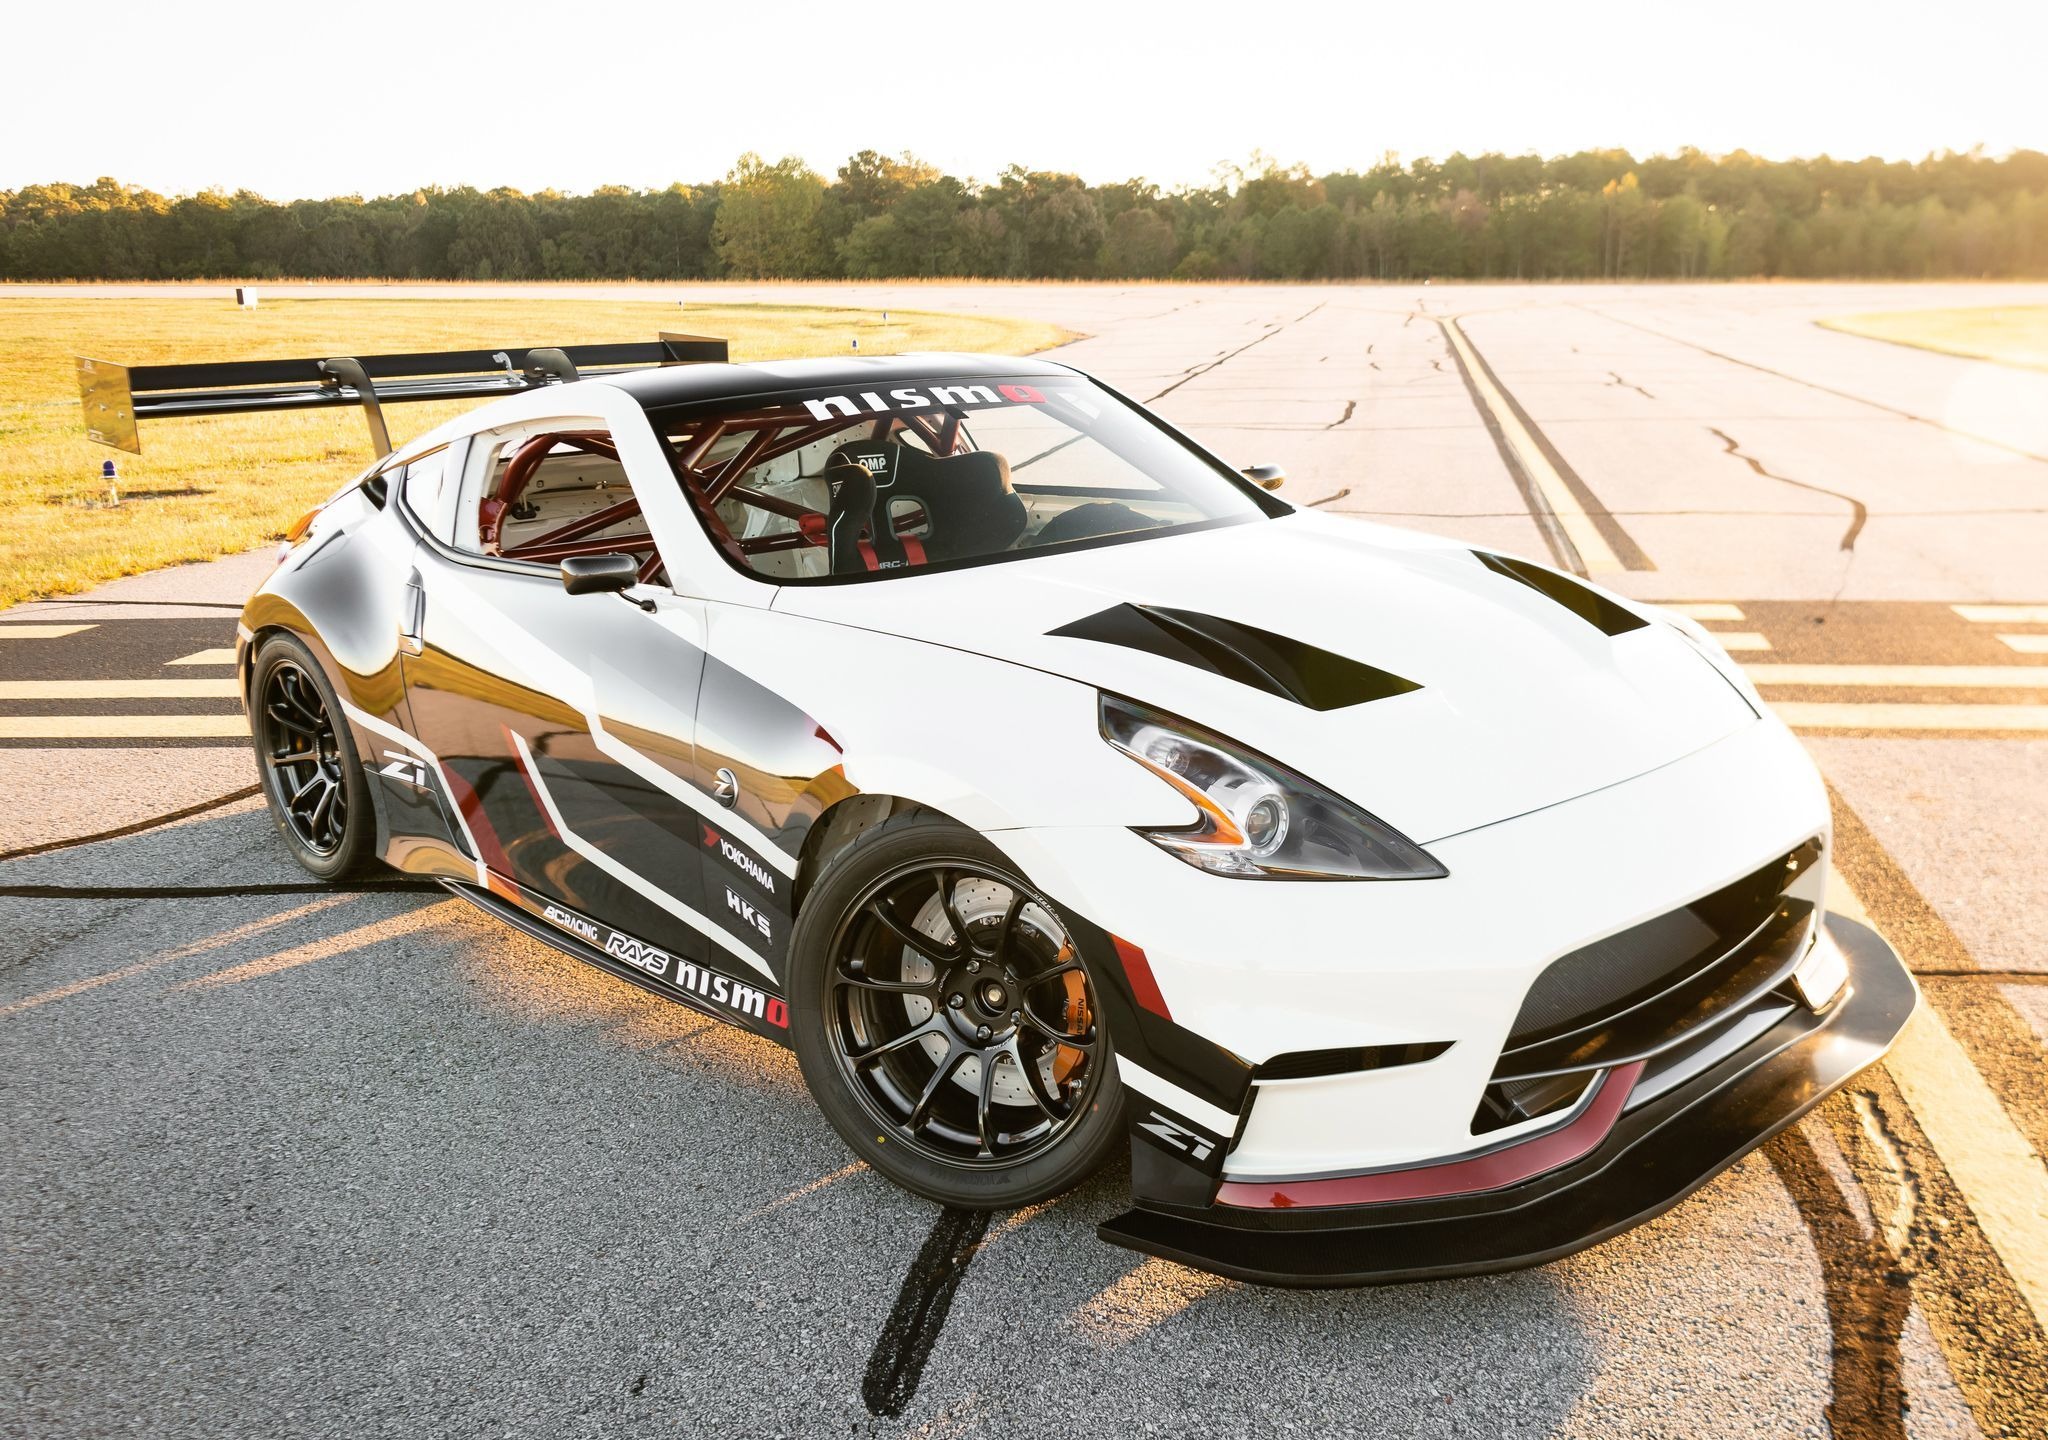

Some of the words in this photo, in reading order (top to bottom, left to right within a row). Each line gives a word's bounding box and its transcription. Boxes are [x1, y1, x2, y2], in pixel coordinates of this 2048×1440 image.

[802, 384, 1047, 421] nismo
[859, 457, 887, 470] OMP
[380, 749, 425, 786] Z1
[720, 838, 775, 894] YOKOHAMA
[726, 889, 771, 938] HKS
[606, 932, 669, 975] RAYS
[676, 960, 790, 1030] nismo
[1136, 1110, 1216, 1161] Z1
